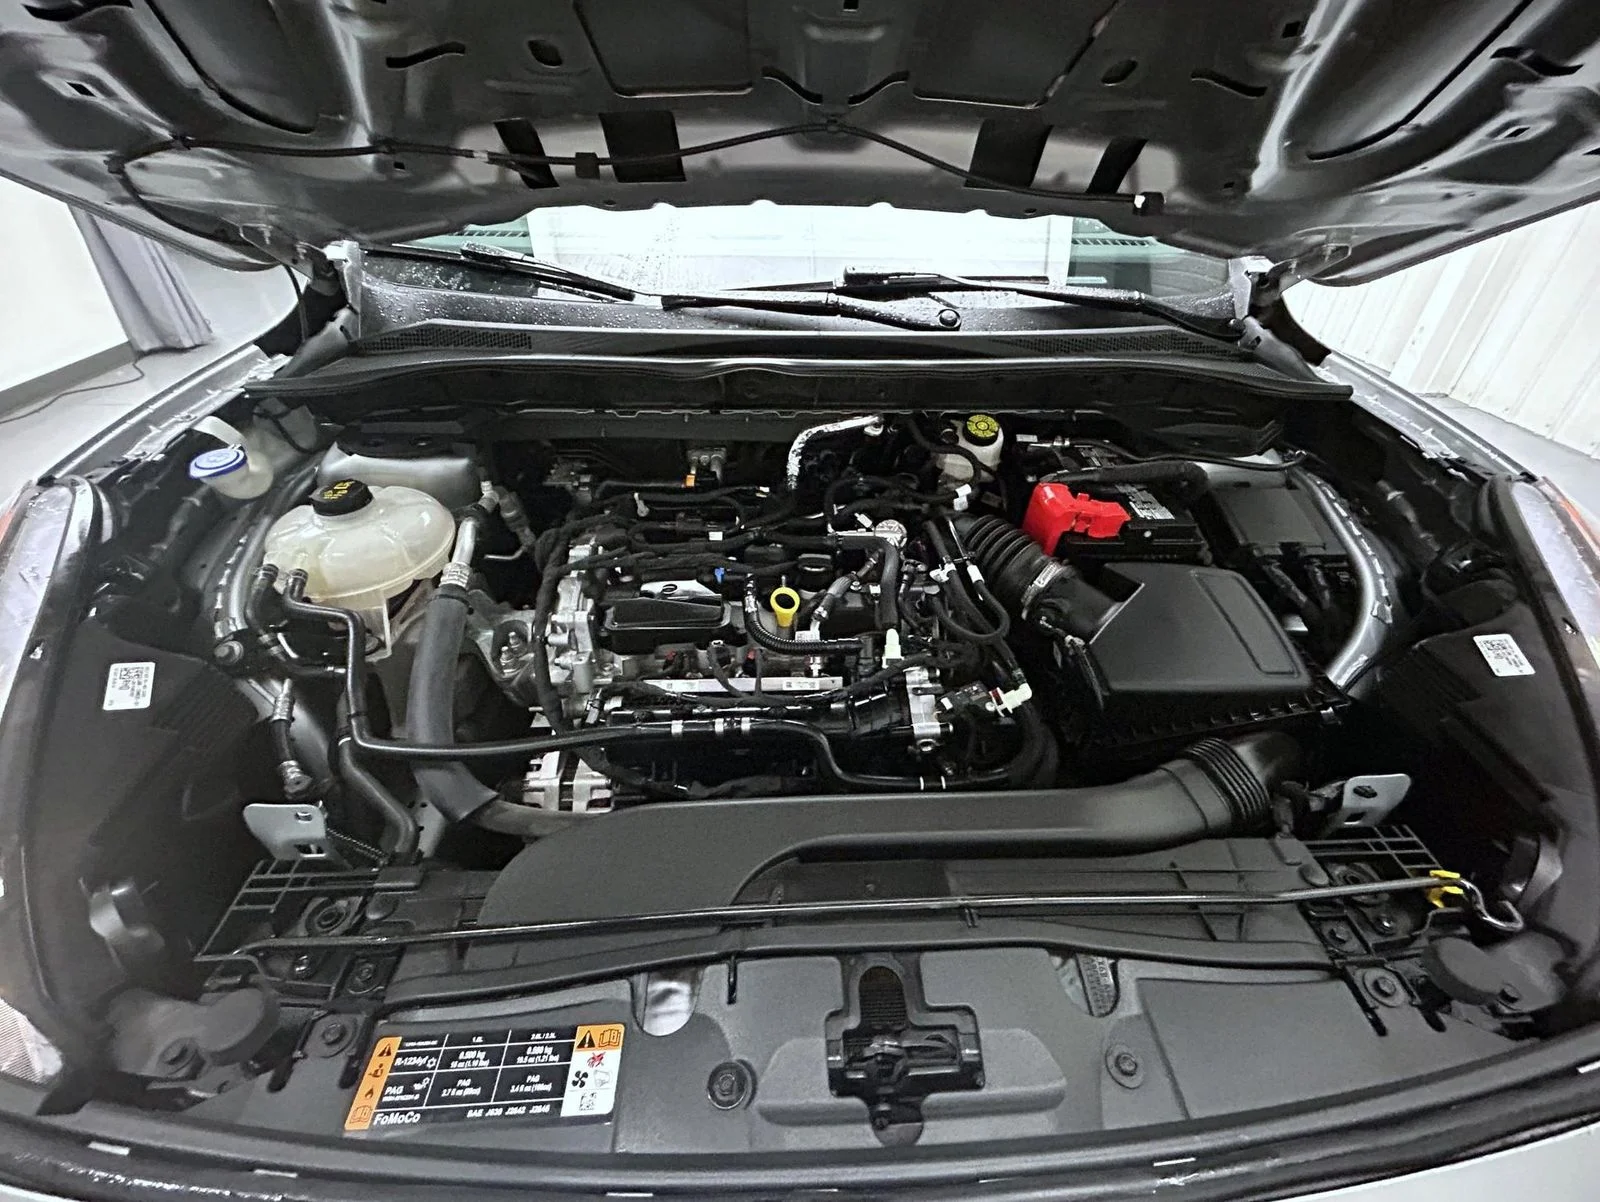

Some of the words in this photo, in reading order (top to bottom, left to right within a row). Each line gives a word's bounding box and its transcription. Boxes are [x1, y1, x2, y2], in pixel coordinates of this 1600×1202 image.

[394, 1056, 428, 1066] R-1234yf
[385, 1086, 404, 1095] PAG
[373, 1111, 420, 1125] FoMoCo
